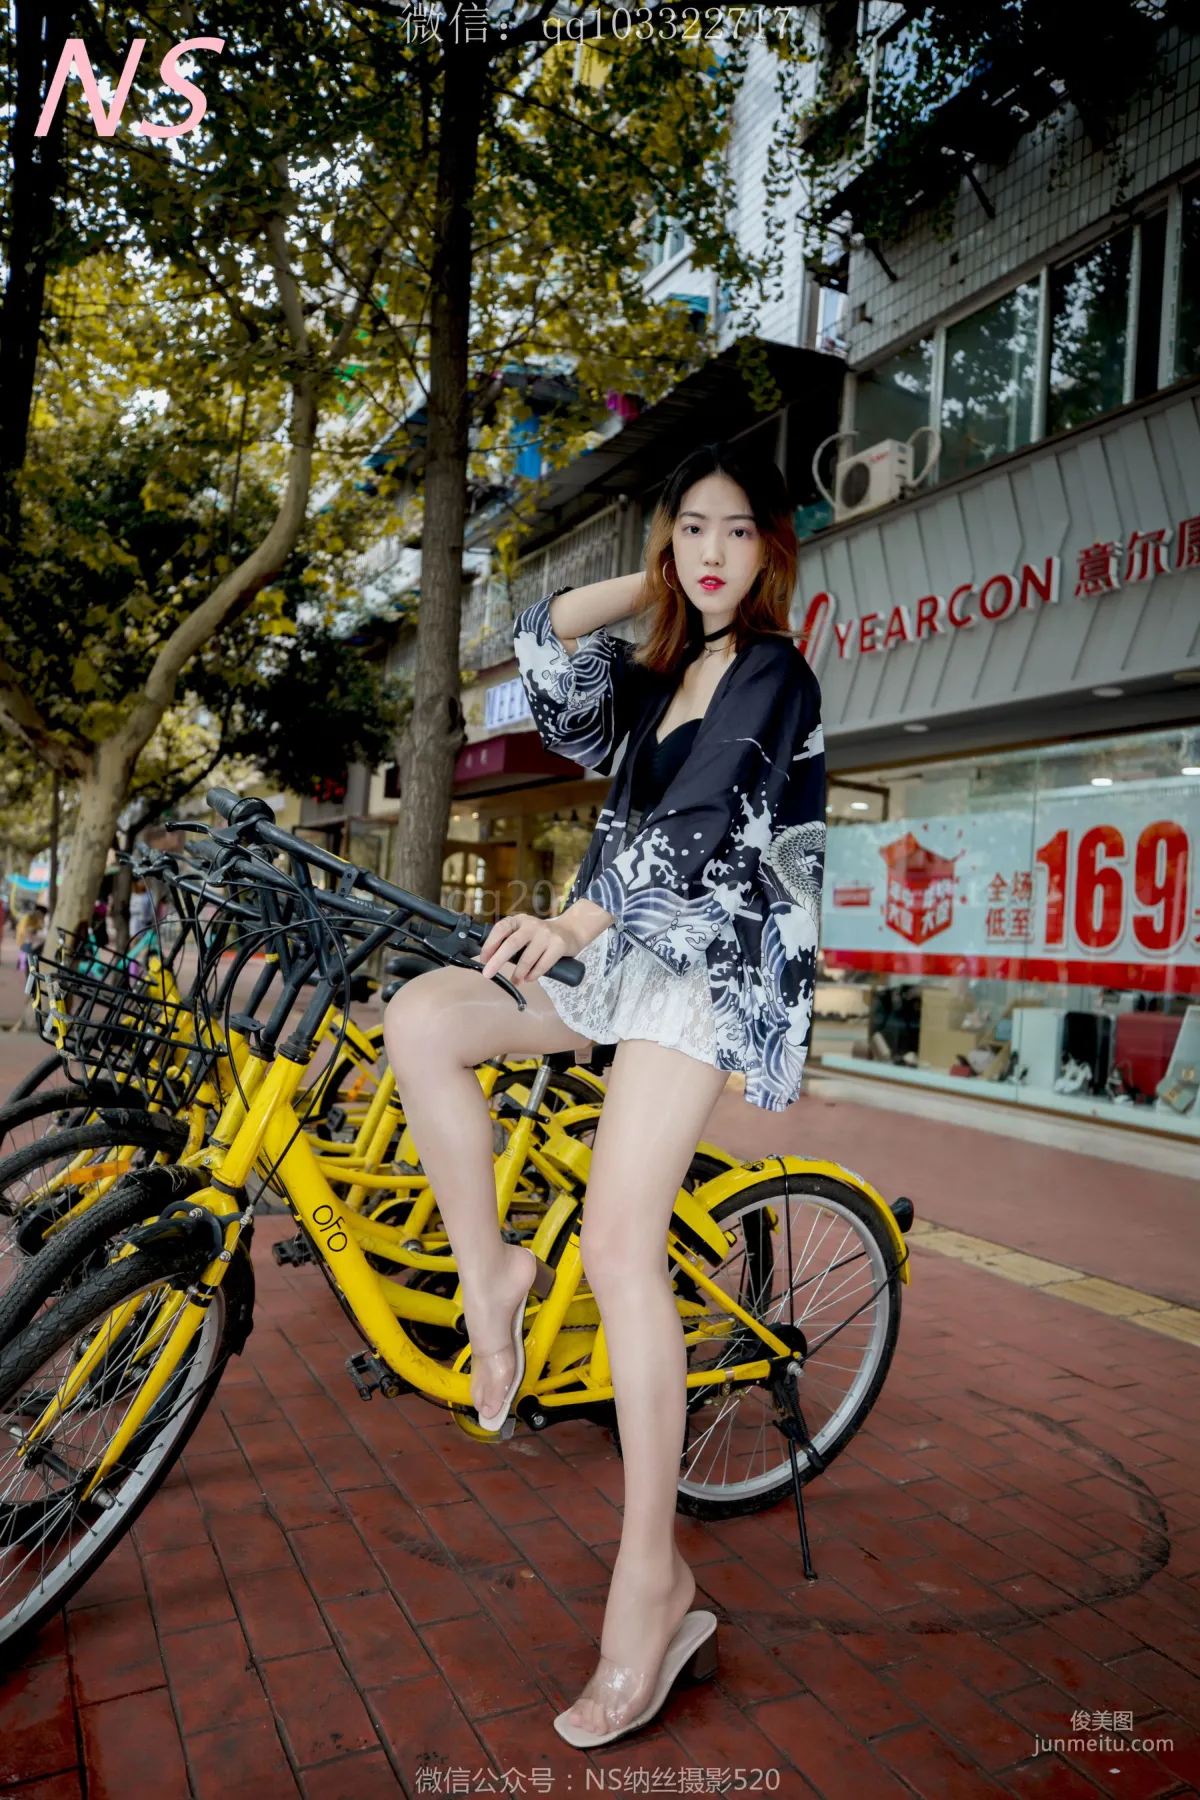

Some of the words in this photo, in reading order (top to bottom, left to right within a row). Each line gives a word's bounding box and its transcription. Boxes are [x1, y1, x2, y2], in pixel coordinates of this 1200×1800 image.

[834, 556, 1060, 660] YEARCON
[987, 871, 1032, 901] 全场
[1036, 820, 1190, 951] 169
[985, 906, 1032, 937] 低至
